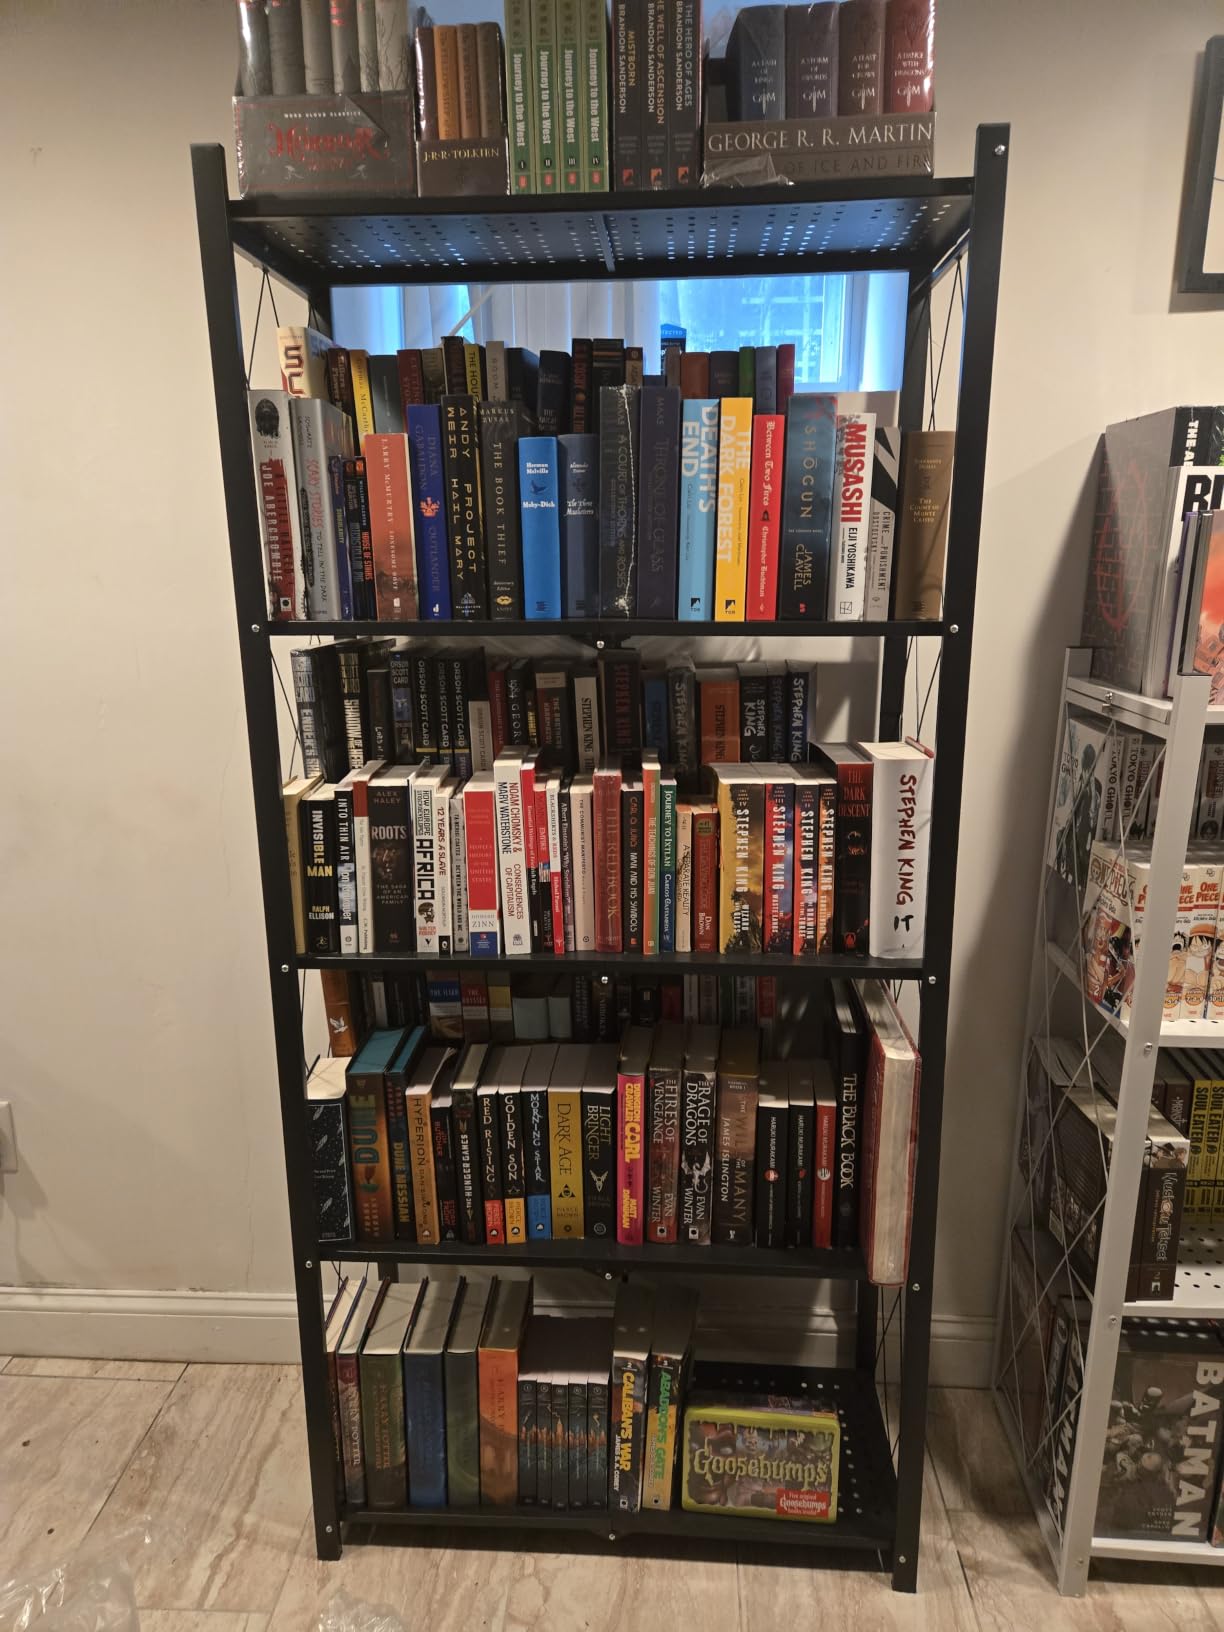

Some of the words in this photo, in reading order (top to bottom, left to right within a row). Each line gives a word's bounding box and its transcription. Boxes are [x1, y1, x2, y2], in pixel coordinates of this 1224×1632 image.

[619, 4, 627, 53] BRANDON
[684, 4, 693, 25] THE
[627, 31, 636, 86] MISTBORN
[684, 28, 693, 58] HERO
[513, 54, 524, 91] Journey
[540, 51, 550, 88] Journey
[564, 49, 575, 87] Journey
[588, 48, 599, 86] Journey
[684, 61, 692, 77] OF
[515, 92, 524, 102] to
[541, 90, 550, 100] to
[565, 88, 574, 98] to
[589, 88, 599, 98] to
[619, 55, 627, 113] SANDERSON
[684, 80, 692, 107] AGES
[515, 104, 524, 119] the
[541, 102, 551, 117] the
[566, 100, 575, 115] the
[590, 100, 599, 114] the
[516, 121, 525, 146] West
[542, 119, 552, 144] West
[566, 117, 576, 143] West
[590, 116, 600, 142] West
[708, 130, 788, 152] GEORGE
[797, 129, 814, 148] R.
[822, 128, 840, 146] R.
[847, 122, 932, 145] MARTIN
[851, 156, 888, 172] AND
[448, 407, 457, 459] WEIR
[459, 407, 471, 459] ANDY
[720, 415, 736, 475] DARK
[493, 442, 503, 469] THE
[681, 421, 700, 478] END
[698, 406, 718, 513] DEATH'S
[735, 431, 751, 470] THE
[262, 465, 273, 487] JOE
[840, 423, 867, 523] MUSASHI
[451, 478, 460, 524] HAIL
[495, 477, 505, 516] BOOK
[522, 501, 556, 509] Moby-Dick
[265, 495, 283, 581] ABERCROMBIE
[463, 483, 477, 573] PROJECT
[717, 483, 735, 564] FOREST
[847, 527, 858, 541] EIJI
[881, 511, 891, 534] CRIME
[362, 531, 371, 550] HOUSE
[363, 551, 372, 559] OF
[496, 523, 507, 566] THIEF
[364, 560, 373, 580] STAIRS
[454, 535, 464, 581] MARY
[794, 543, 804, 591] CLAVELL
[803, 549, 813, 585] JAMES
[845, 542, 857, 589] YOSHIKAWA
[877, 546, 888, 591] PUNISHMENT
[417, 660, 425, 692] ORSON
[453, 662, 463, 693] ORSON
[420, 694, 428, 721] SCOTT
[455, 695, 464, 723] SCOTT
[582, 698, 593, 732] STEPHEN
[757, 699, 765, 737] STEPHEN
[792, 678, 804, 727] STEPHEN
[421, 722, 430, 746] CARD
[744, 702, 756, 737] KING
[457, 724, 465, 747] CARD
[584, 733, 593, 753] KING
[791, 731, 803, 761] KING
[337, 798, 348, 819] INTO
[509, 782, 520, 807] NOAM
[664, 790, 673, 826] JOURNEY
[843, 786, 866, 801] DARK
[423, 808, 431, 836] EUROPE
[838, 803, 871, 817] DESCENT
[897, 774, 917, 851] STEPHEN
[312, 810, 324, 864] INVISIBLE
[339, 821, 349, 843] THIN
[371, 825, 407, 841] ROOTS
[510, 808, 522, 845] CHOMSKY
[664, 826, 672, 837] TO
[736, 808, 749, 859] STEPHEN
[772, 806, 785, 856] STEPHEN
[800, 810, 814, 860] STEPHEN
[821, 808, 834, 858] STEPHEN
[340, 845, 350, 860] AIR
[664, 838, 673, 867] IXTLAN
[307, 865, 333, 877] MAN
[416, 838, 435, 900] AFRICA
[505, 867, 513, 876] OF
[736, 866, 748, 893] KING
[772, 863, 785, 890] KING
[800, 868, 813, 894] KING
[820, 865, 833, 891] KING
[896, 857, 916, 906] KING
[506, 876, 515, 917] CAPITALISM
[513, 863, 524, 920] CONSEQUENCES
[1196, 892, 1220, 904] PIECE
[698, 912, 706, 935] BROWN
[704, 915, 712, 930] DAN
[625, 1083, 634, 1121] CRAWLER
[843, 1073, 857, 1101] THE
[1193, 1087, 1208, 1113] SOUL
[1210, 1086, 1224, 1112] SOUL
[482, 1098, 493, 1125] RED
[530, 1093, 544, 1147] MORNING
[652, 1081, 665, 1144] VENGEANCE
[664, 1085, 677, 1126] FIRES
[685, 1082, 698, 1146] DRAGONS
[697, 1087, 711, 1126] RAGE
[505, 1095, 517, 1149] GOLDEN
[554, 1103, 572, 1143] DARK
[584, 1105, 600, 1161] BRINGER
[599, 1106, 611, 1146] LIGHT
[664, 1127, 675, 1143] OF
[697, 1128, 708, 1144] OF
[721, 1117, 730, 1147] JAMES
[840, 1104, 857, 1148] BLACK
[1190, 1113, 1206, 1144] EATER
[1206, 1113, 1222, 1144] EATER
[484, 1130, 496, 1183] RISING
[624, 1121, 641, 1163] CARL
[508, 1153, 518, 1181] SON
[533, 1150, 546, 1183] STAR
[559, 1147, 573, 1176] AGE
[721, 1149, 730, 1202] ISLINGTON
[840, 1151, 855, 1189] BOOK
[651, 1185, 661, 1223] WINTER
[664, 1193, 673, 1217] EVAN
[683, 1187, 694, 1224] WINTER
[696, 1196, 705, 1220] EVAN
[734, 1170, 746, 1222] MANY
[620, 1371, 635, 1440] CALIBAN'S
[619, 1442, 632, 1471] WAR
[693, 1437, 831, 1490] Goosebumps
[1171, 1361, 1224, 1536] BATMAN
[779, 1494, 827, 1512] Goosebumps
